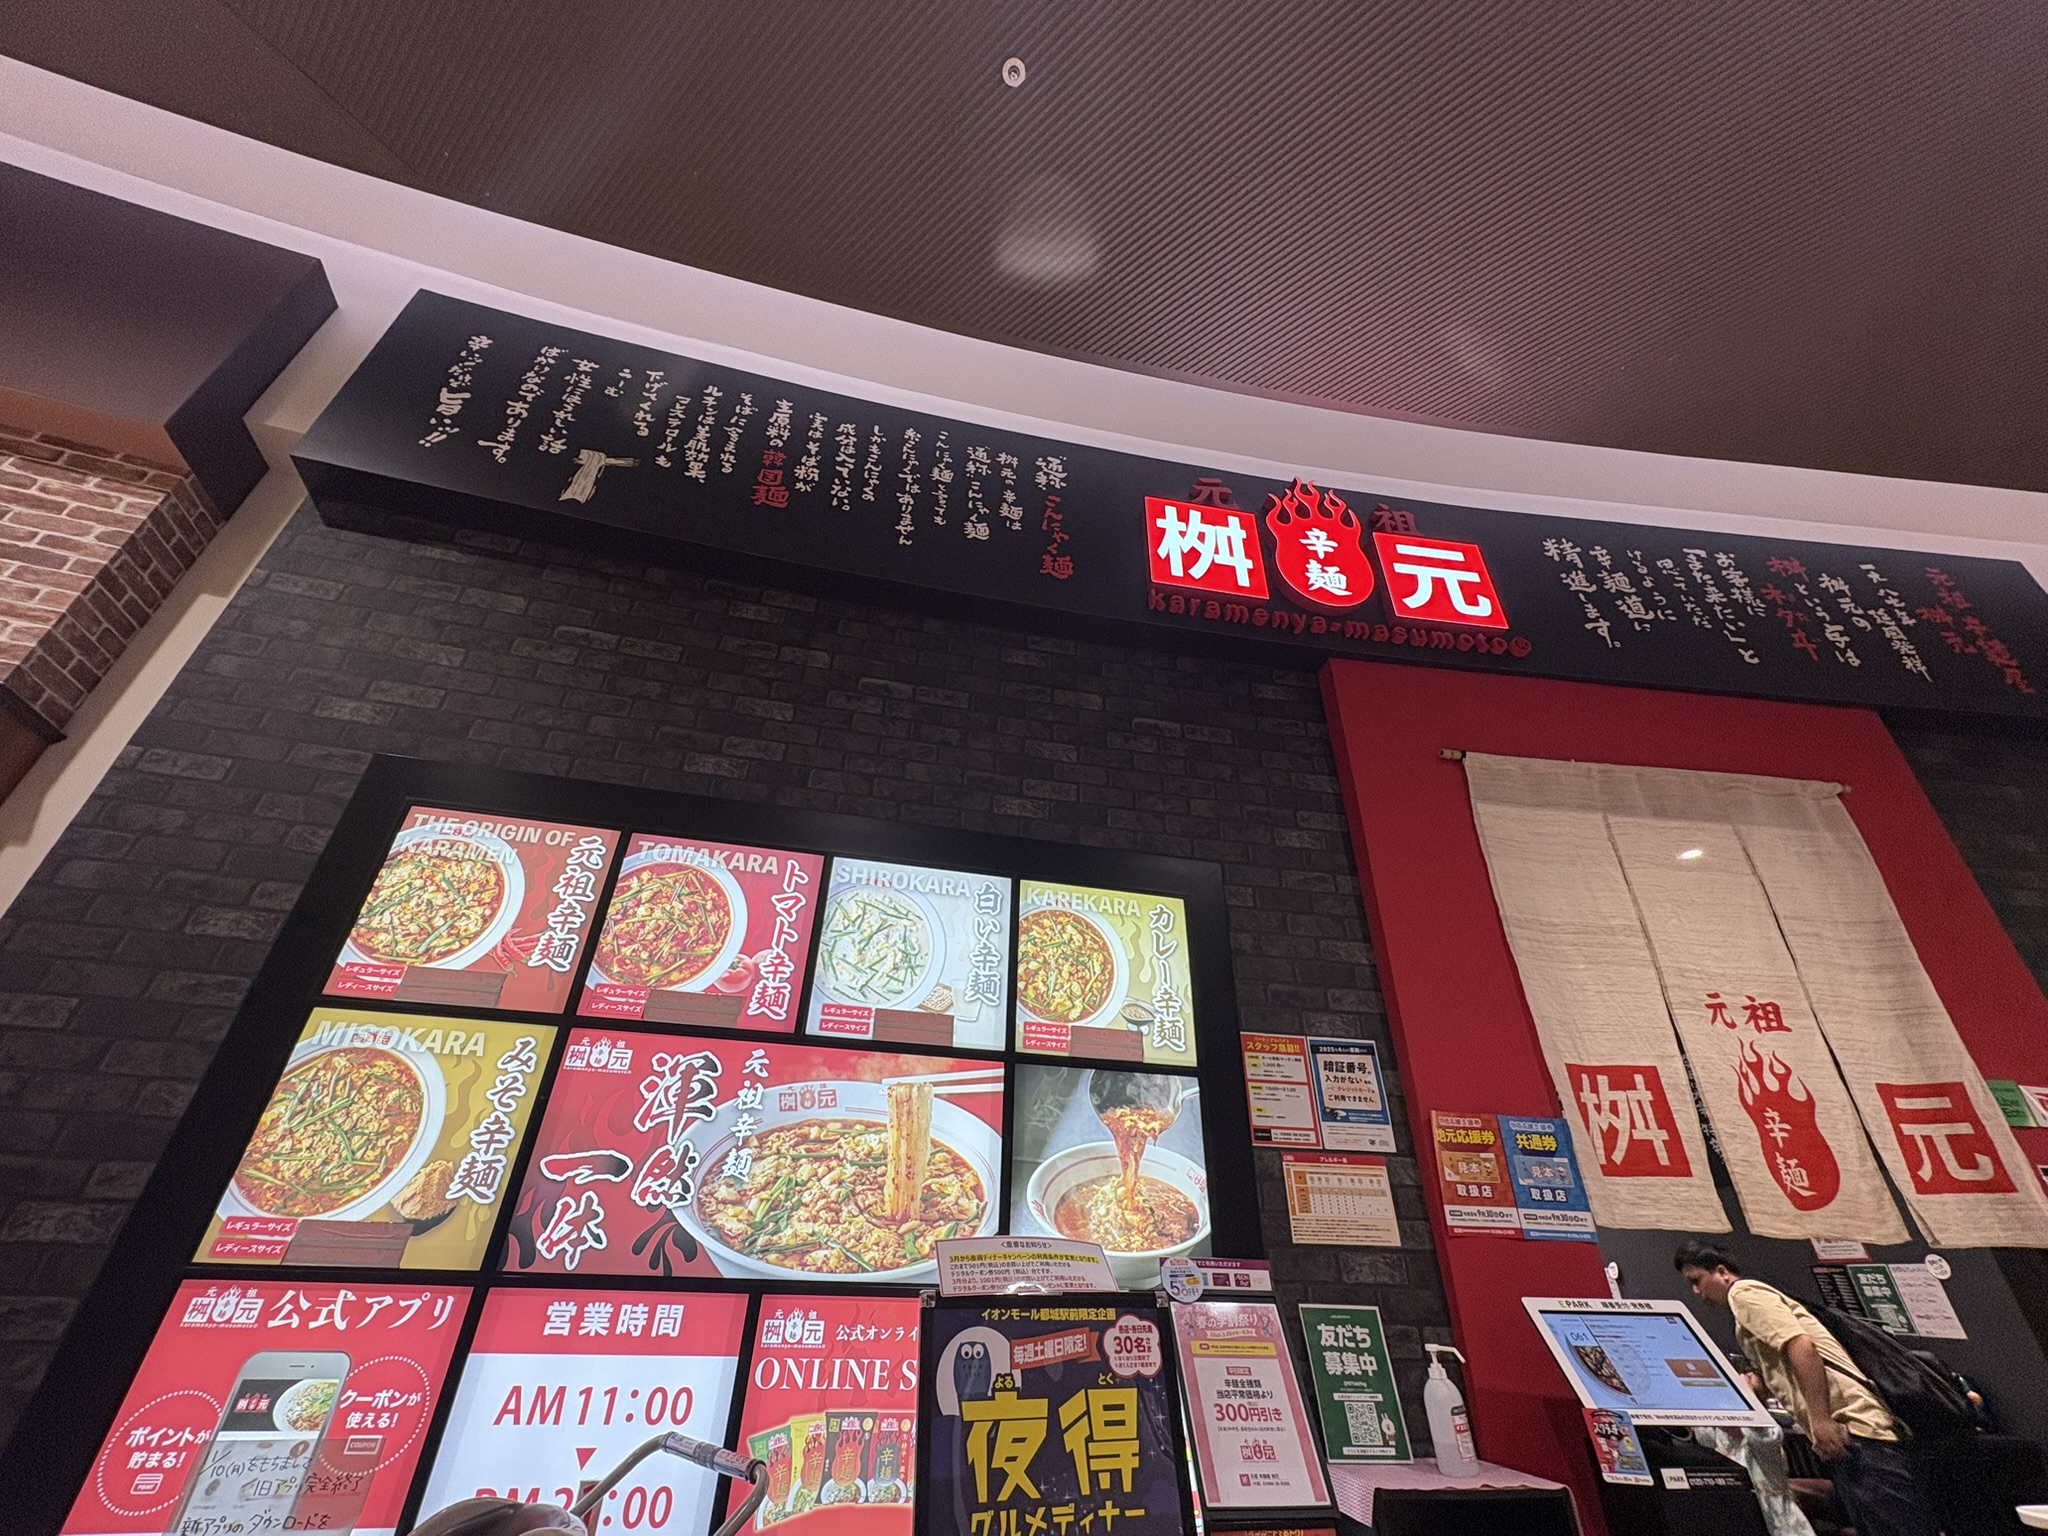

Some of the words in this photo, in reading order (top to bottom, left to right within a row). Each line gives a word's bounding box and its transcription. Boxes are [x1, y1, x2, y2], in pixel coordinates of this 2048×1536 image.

[633, 370, 668, 437] 下げてくれる
[655, 394, 691, 468] コレステロールも
[719, 392, 759, 474] そばに含まれる
[793, 412, 829, 493] 実はそば粉が
[995, 451, 1024, 531] 桝元の辛麺は
[1299, 527, 1352, 597] 辛麺
[1590, 546, 1655, 632] 辛麺道に
[1627, 550, 1677, 621] けるように
[1714, 552, 1767, 617] お客様に
[413, 813, 459, 832] THE
[464, 817, 542, 844] ORIGIN
[544, 829, 576, 847] OF
[638, 841, 778, 875] TOMAKARA
[836, 865, 972, 898] SHIROKARA
[528, 835, 606, 972] 元祖辛麺
[1026, 887, 1142, 917] KAREKARA
[747, 859, 809, 1021] トマト辛麺
[965, 881, 1003, 1006] 白い辛麺
[345, 965, 402, 977] レギュラーサイズ
[1148, 904, 1186, 1052] カレー辛麺
[337, 981, 394, 993] レディースサイズ
[596, 986, 647, 998] レギュラーサイズ
[591, 1002, 642, 1013] レディースサイズ
[823, 1006, 871, 1019] レギュラーサイズ
[1705, 992, 1792, 1034] 元祖
[312, 1020, 486, 1057] MISOKARA
[821, 1021, 868, 1033] レディースサイズ
[1024, 1024, 1069, 1036] レギュラーサイズ
[1024, 1038, 1069, 1050] レディースサイズ
[445, 1036, 539, 1205] みそ辛麺
[721, 1049, 770, 1183] 元祖辛麺
[1516, 1132, 1558, 1151] 共通券
[1763, 1107, 1817, 1197] 辛麺
[1458, 1162, 1480, 1174] 見本
[1531, 1166, 1554, 1178] 見本
[1456, 1184, 1493, 1198] 取扱店
[1530, 1188, 1567, 1202] 取扱店
[225, 1221, 293, 1233] レギュラーサイズ
[215, 1243, 282, 1255] レディースサイズ
[267, 1288, 455, 1331] 公式アプリ
[981, 1308, 1117, 1321] イオンモール都城駅前限定企画
[1558, 1300, 1593, 1309] EPARK
[543, 1302, 685, 1338] 営業時間
[1317, 1324, 1372, 1348] 友だち
[1570, 1332, 1589, 1341] 061
[755, 1357, 890, 1390] ONLINE
[1323, 1351, 1378, 1377] 募集中
[994, 1376, 1014, 1389] よる
[1098, 1373, 1115, 1385] とく
[340, 1389, 421, 1410] クーポンが
[1213, 1403, 1283, 1422] 300円引き
[346, 1412, 398, 1429] 使える!
[125, 1427, 211, 1448] ポイントが
[961, 1388, 1140, 1503] 夜得
[126, 1452, 185, 1470] 貯まる!
[879, 1448, 894, 1479] 辛麺
[252, 1473, 364, 1497] 旧アプリ完全終了
[971, 1501, 1146, 1536] グルメディナー
